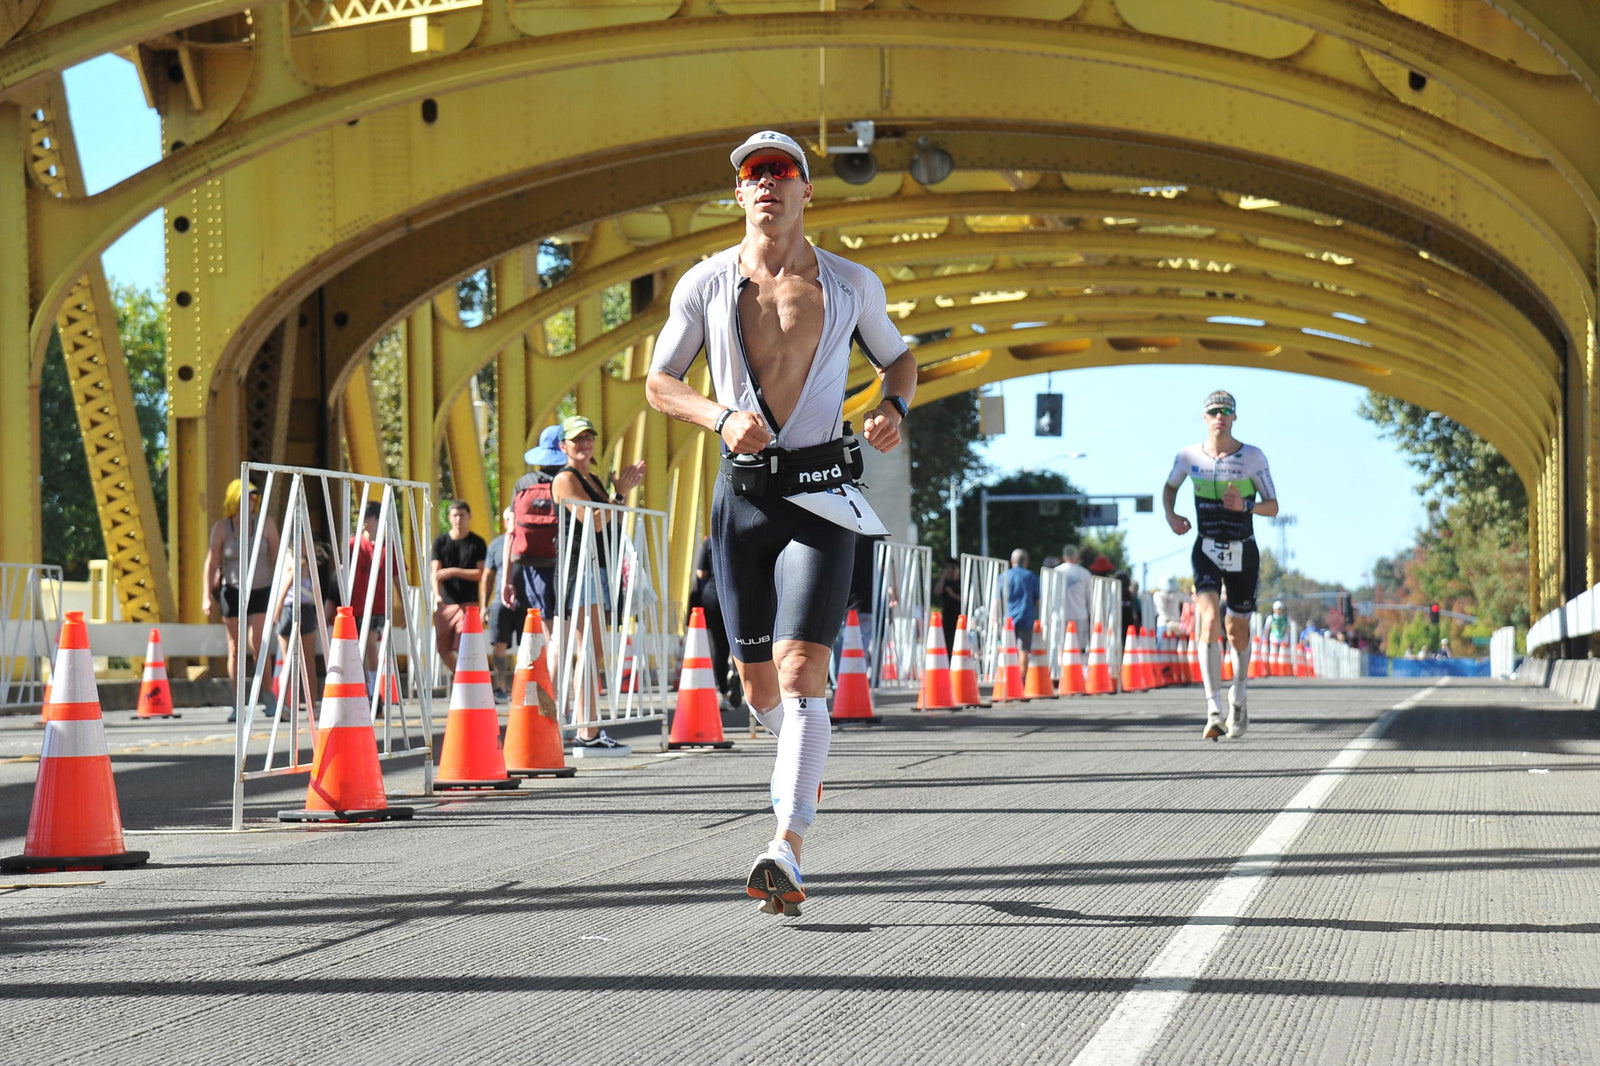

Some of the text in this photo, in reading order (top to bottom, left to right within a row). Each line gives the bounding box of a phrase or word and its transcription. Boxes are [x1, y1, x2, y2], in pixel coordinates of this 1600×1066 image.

[799, 463, 843, 484] nerd
[1217, 551, 1233, 562] 41
[734, 634, 771, 646] HUUB
